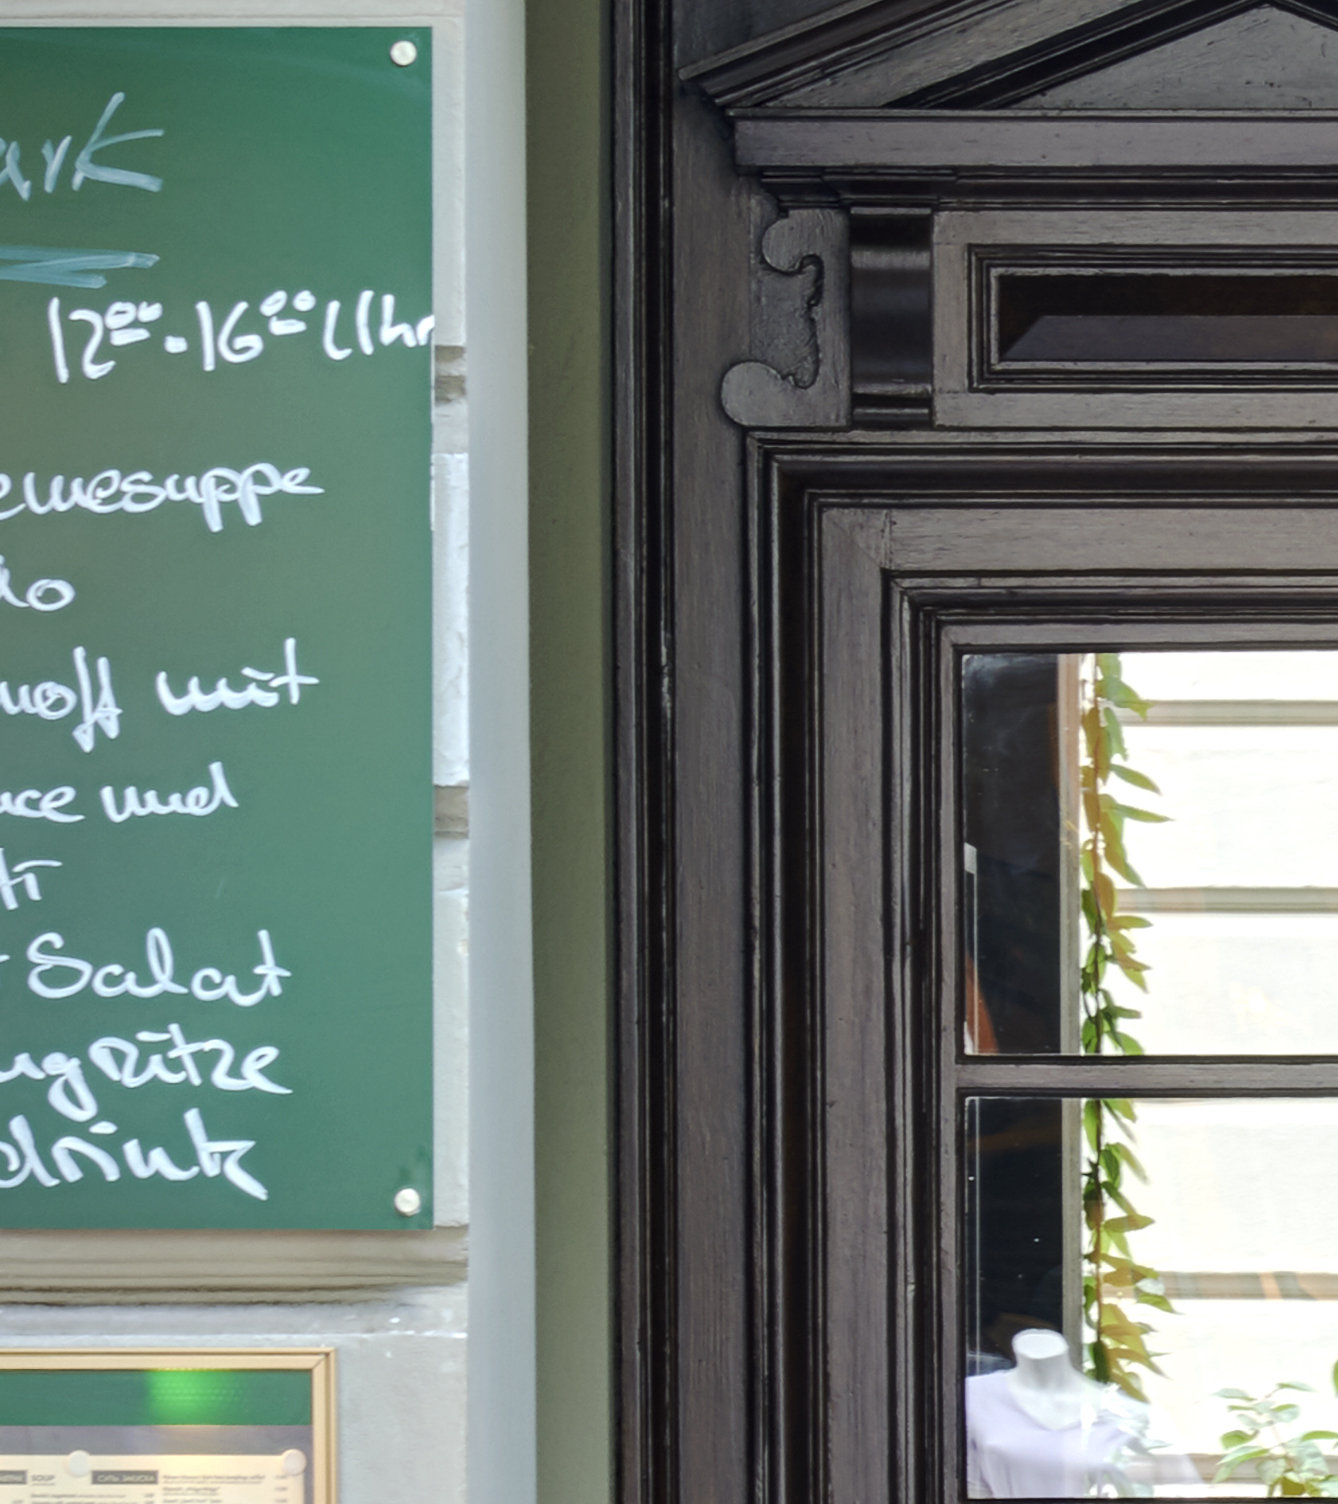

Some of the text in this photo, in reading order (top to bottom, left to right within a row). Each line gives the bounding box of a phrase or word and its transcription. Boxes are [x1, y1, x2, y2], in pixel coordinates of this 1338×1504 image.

[156, 637, 320, 716] mit
[100, 761, 240, 824] und
[26, 927, 292, 1007] Salat
